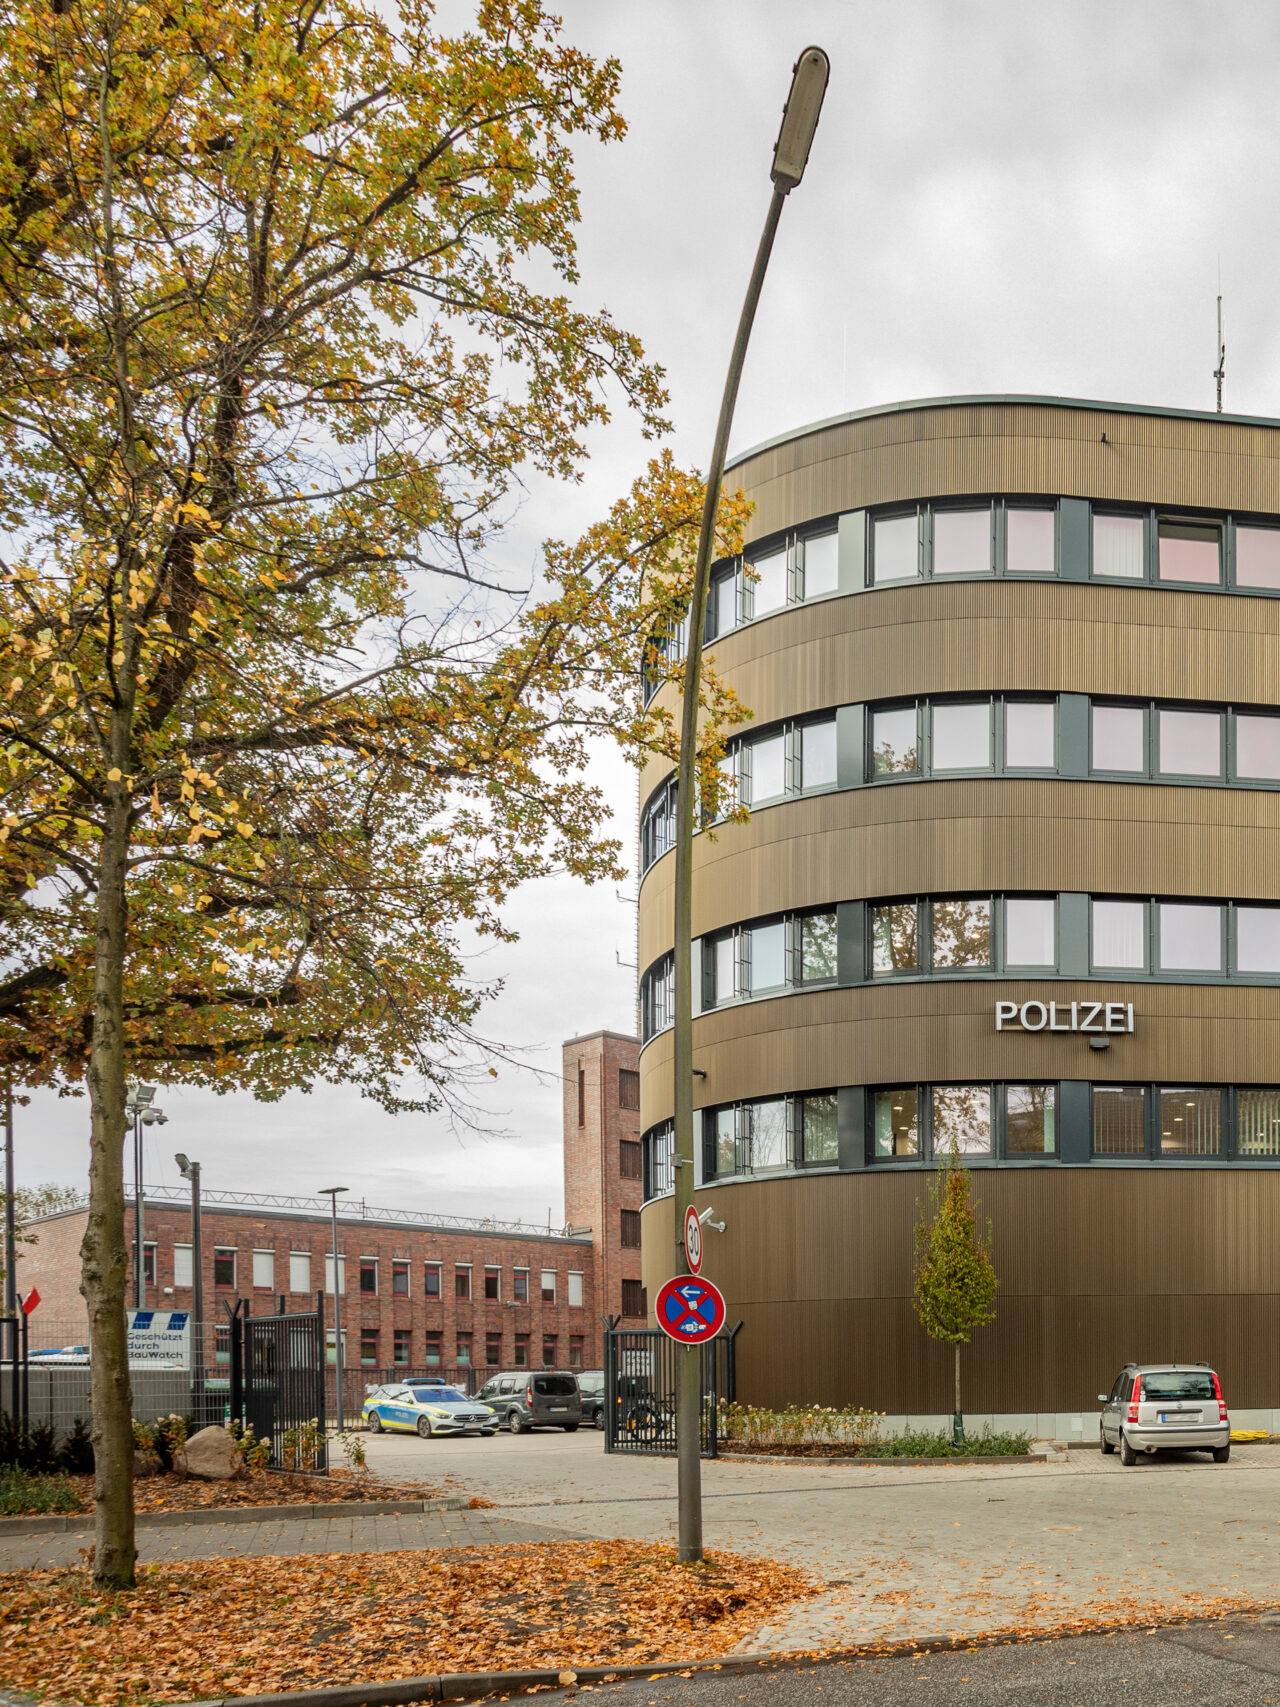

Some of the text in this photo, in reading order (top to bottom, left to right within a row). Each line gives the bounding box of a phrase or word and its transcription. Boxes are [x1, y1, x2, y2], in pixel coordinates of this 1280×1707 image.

[996, 1001, 1134, 1032] POLIZEI
[689, 1224, 699, 1256] 30
[127, 1333, 183, 1341] Geschützt
[127, 1342, 159, 1350] durch
